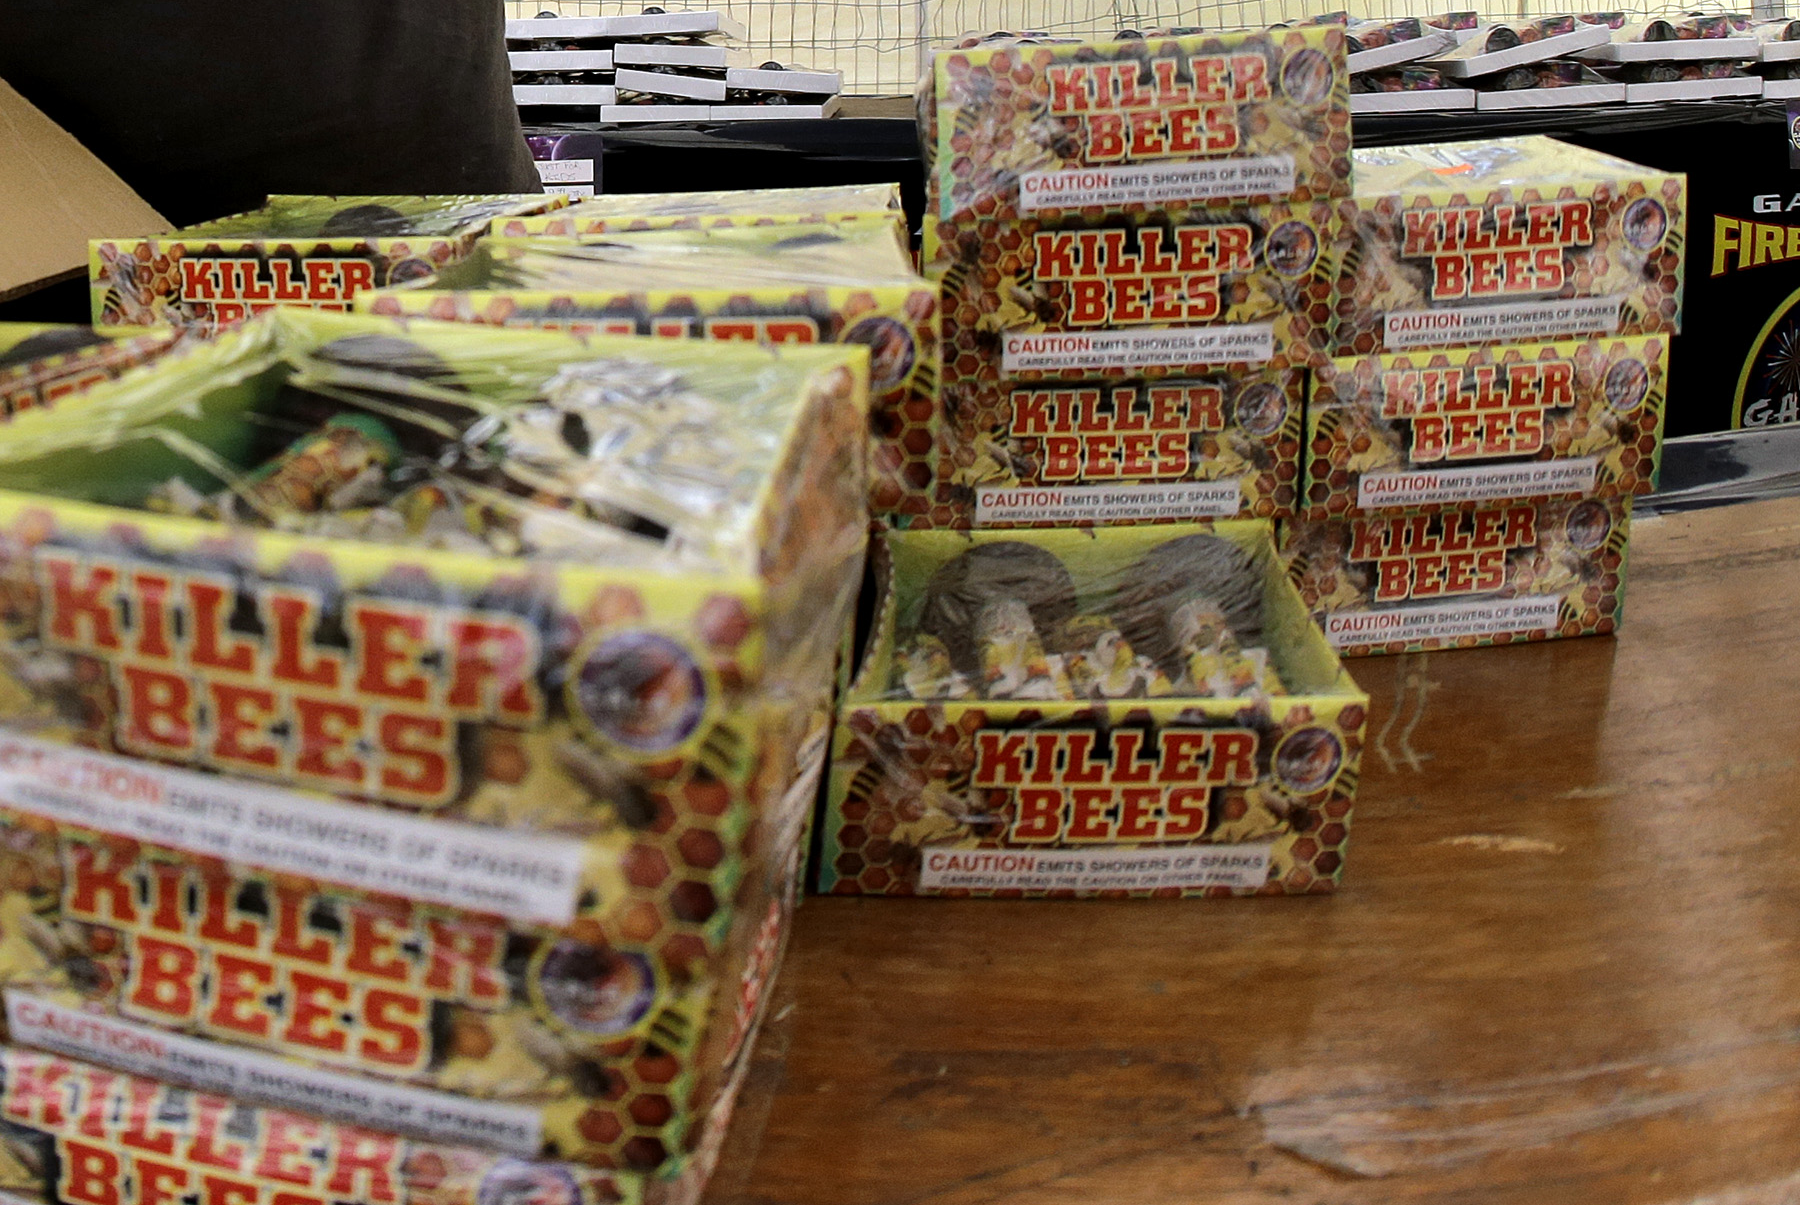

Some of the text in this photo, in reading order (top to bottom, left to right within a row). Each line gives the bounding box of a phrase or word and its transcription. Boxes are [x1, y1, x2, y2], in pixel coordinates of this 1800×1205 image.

[1046, 52, 1272, 114] KILLER
[1087, 104, 1240, 161] BEES
[1025, 167, 1290, 192] CAUTION EMITS SHOWERS OF SPARKS
[1034, 224, 1254, 280] KILLER
[1401, 198, 1594, 256] KILLER
[180, 258, 374, 302] KILLER
[1067, 273, 1221, 326] BEES
[1432, 247, 1565, 300] BEES
[1008, 334, 1269, 354] CAUTION EMITS SHOWERS OF SPARKS
[1389, 306, 1616, 332] CAUTION EMITS SHOWERS OF SPARKS
[1010, 385, 1224, 437] KILLER
[1381, 359, 1576, 418] KILLER
[1042, 432, 1190, 480] BEES
[1409, 408, 1544, 462] BEES
[981, 491, 1235, 507] CAUTION EMITS SHOWERS OF SPARKS
[1364, 468, 1592, 494] CAUTION EMITS SHOWERS OF SPARKS
[1348, 506, 1537, 562] KILLER
[1374, 549, 1507, 602] BEES
[35, 549, 543, 729] KILLER
[1330, 605, 1555, 633] CAUTION EMITS SHOWERS OF SPARKS
[115, 661, 465, 807] BEES
[973, 728, 1258, 788] KILLER
[1009, 783, 1211, 843] BEES
[929, 854, 1263, 873] CAUTION EMITS SHOWERS OF SPARKS
[65, 841, 512, 1004] KILLER
[129, 932, 436, 1072] BEES
[14, 1002, 167, 1061] CAUTION
[2, 1051, 402, 1205] KILLER
